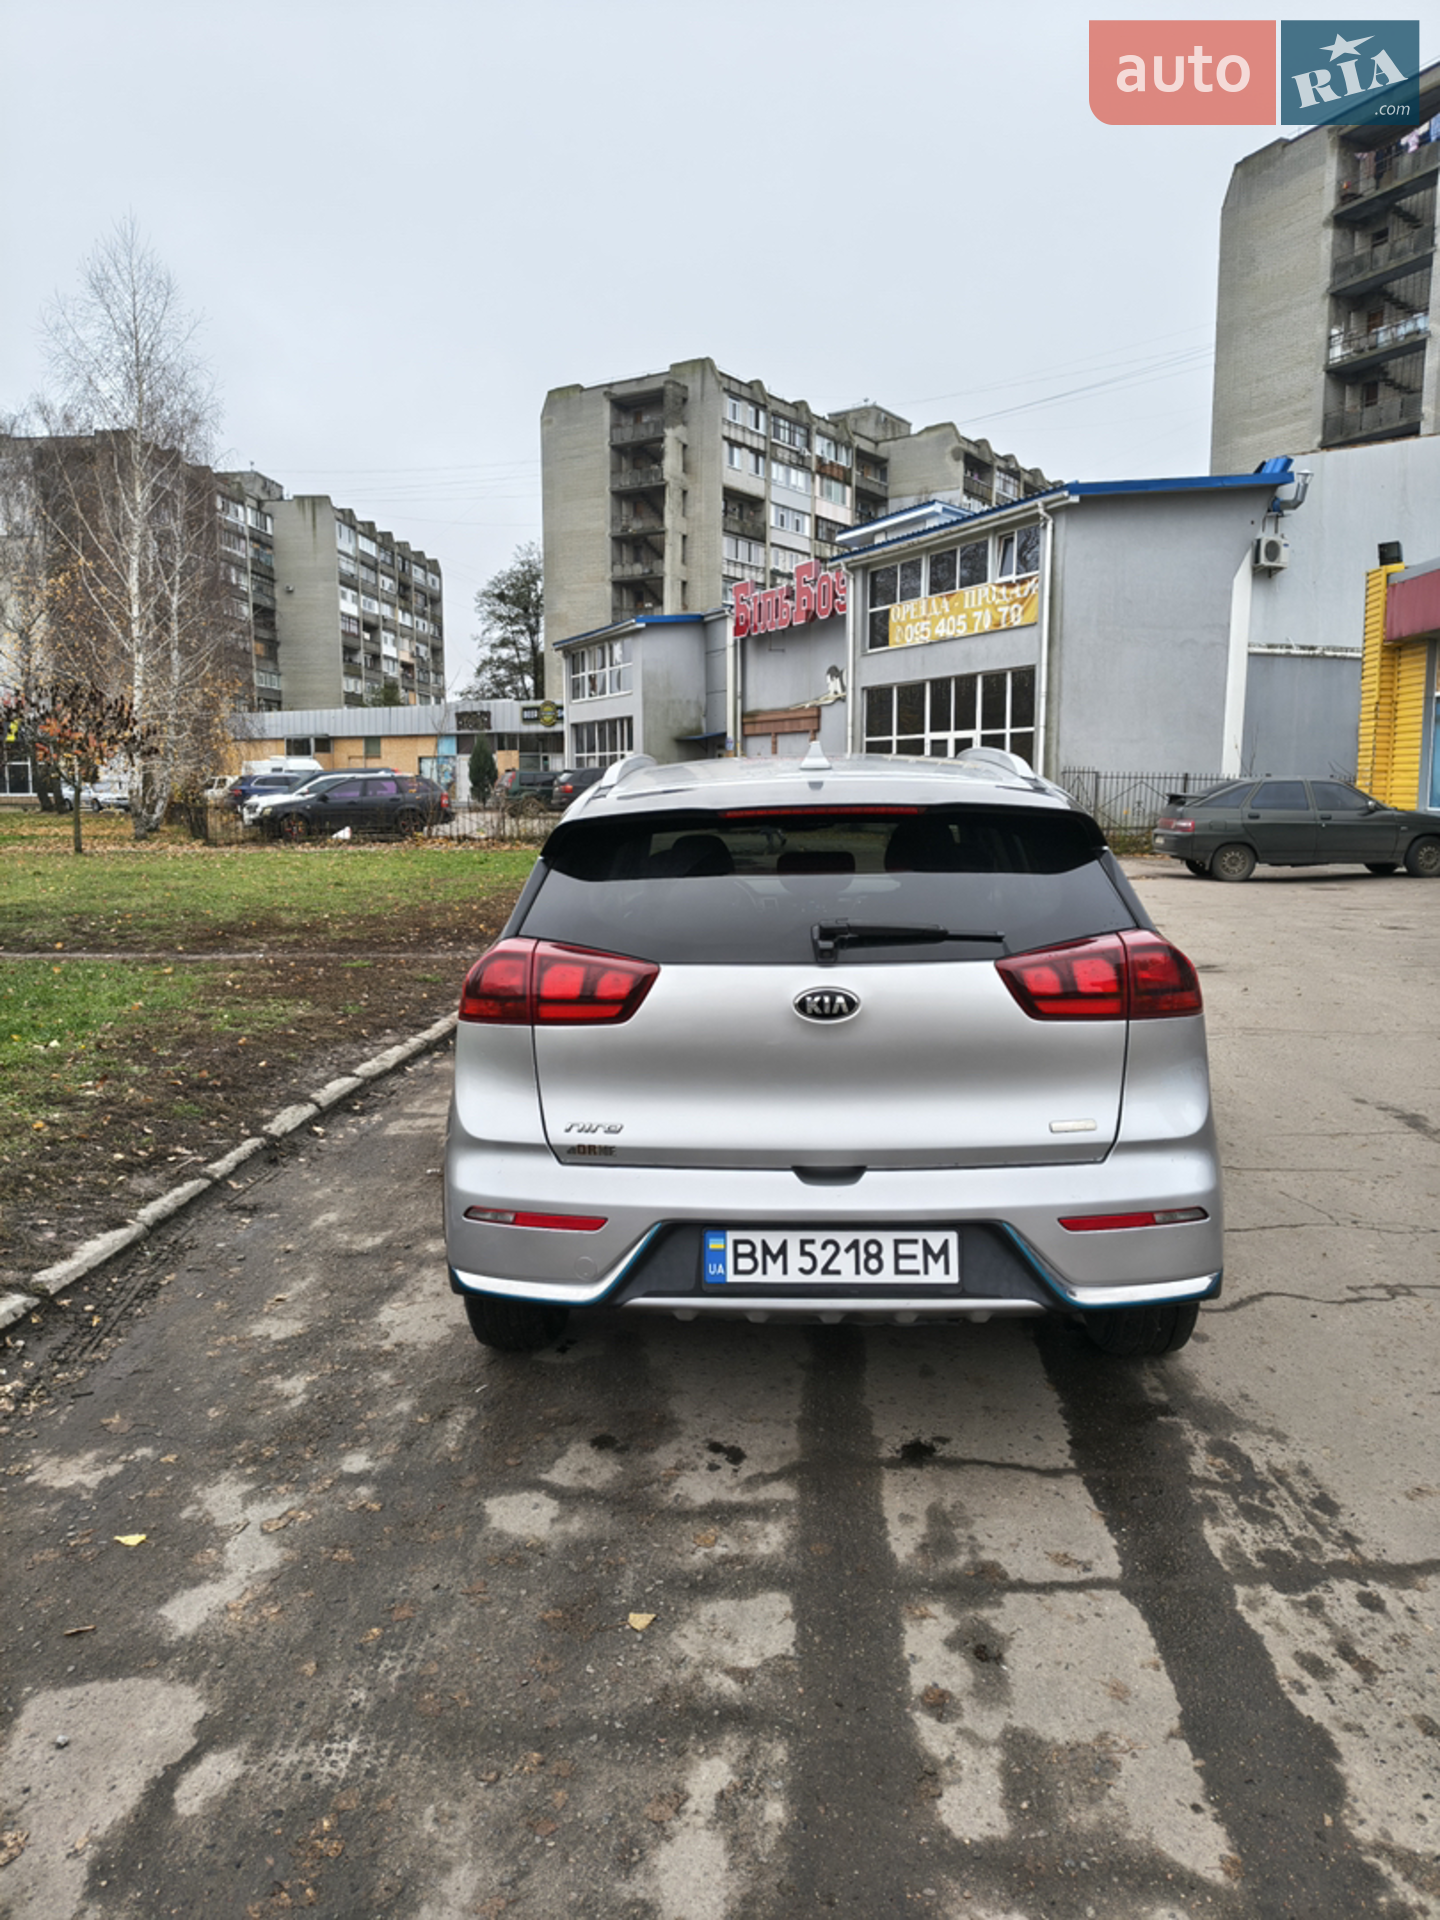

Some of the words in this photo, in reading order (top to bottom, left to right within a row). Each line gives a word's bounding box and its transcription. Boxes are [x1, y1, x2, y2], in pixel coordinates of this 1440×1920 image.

[935, 614, 967, 637] 405
[805, 995, 849, 1015] KIA
[732, 1238, 788, 1276] BM
[798, 1238, 884, 1276] 5218
[893, 1238, 951, 1276] EM
[708, 1263, 726, 1275] UA
